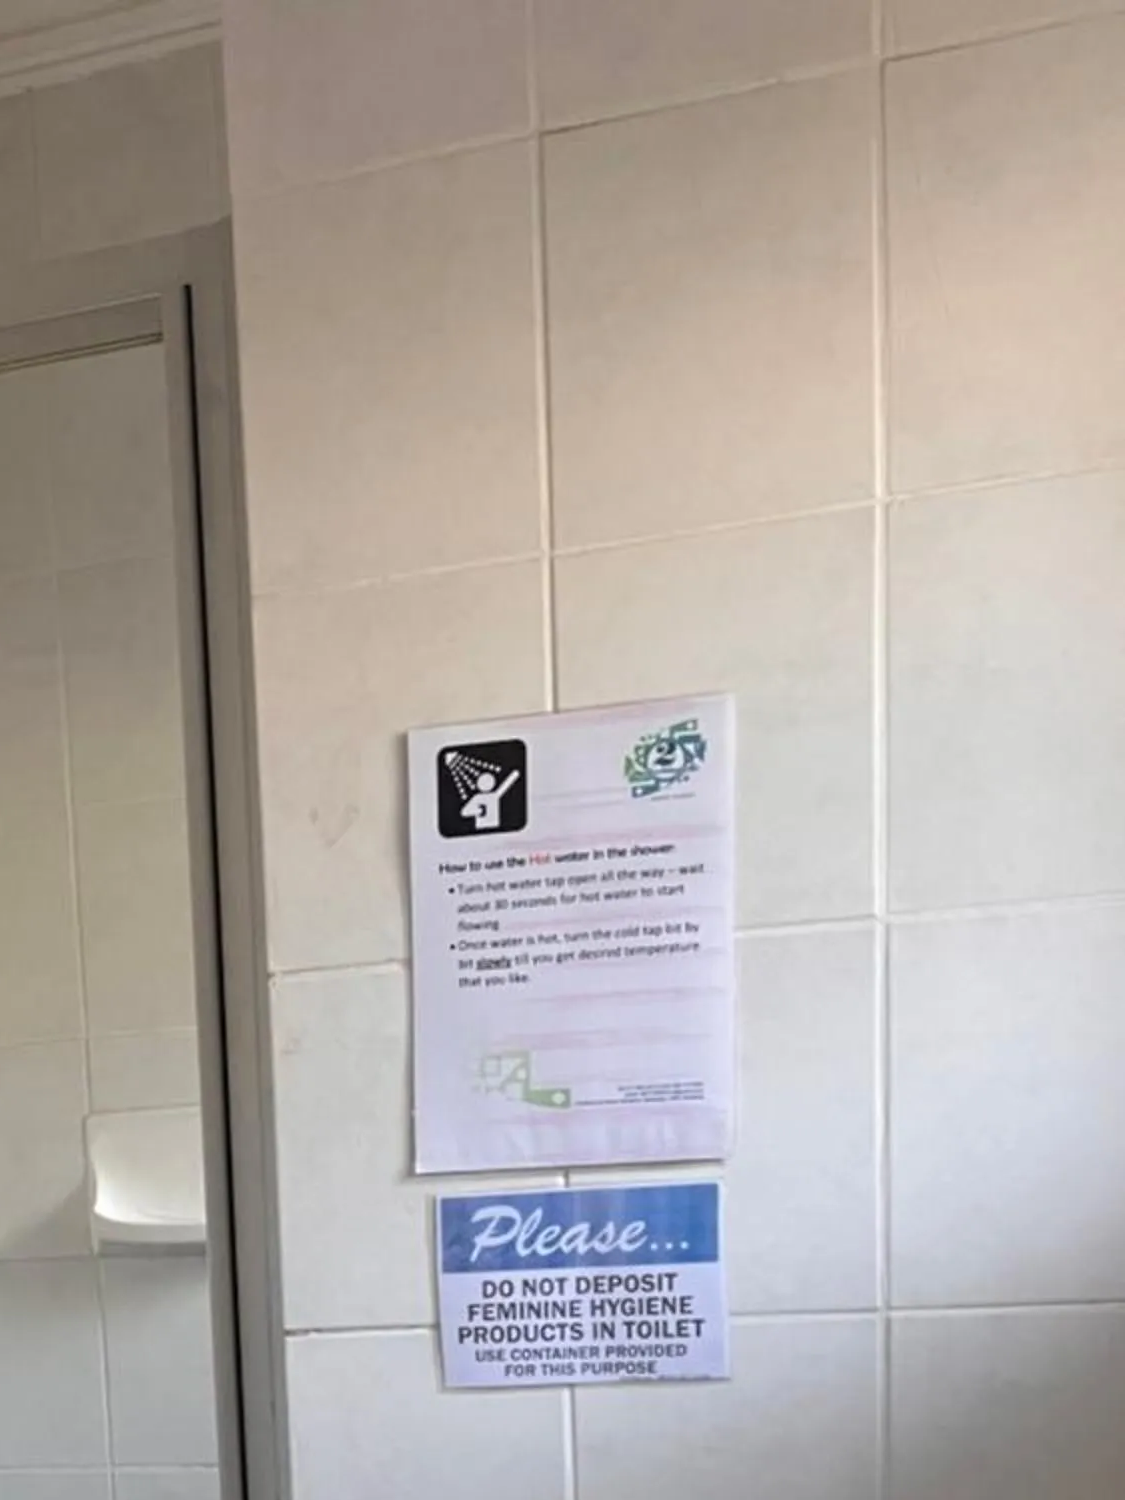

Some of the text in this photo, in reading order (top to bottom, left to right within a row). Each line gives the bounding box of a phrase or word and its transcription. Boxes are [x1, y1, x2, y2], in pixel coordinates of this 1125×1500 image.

[438, 844, 675, 874] How to use the Hot water in the shower
[457, 882, 483, 895] Turn
[486, 880, 505, 892] hot
[508, 878, 542, 890] water
[545, 876, 565, 889] tap
[567, 873, 597, 887] open
[600, 870, 615, 882] all
[617, 869, 637, 881] the
[640, 867, 664, 880] way
[678, 862, 704, 875] wait
[457, 884, 684, 914] about 30 seconds for hot water to start
[458, 919, 500, 932] flowing
[458, 939, 487, 951] Once
[489, 937, 524, 949] water
[526, 935, 536, 946] is
[563, 932, 589, 943] turn
[591, 928, 612, 941] the
[614, 926, 640, 939] cold
[642, 925, 664, 938] tap
[665, 922, 682, 935] bit
[684, 920, 700, 934] by
[458, 941, 700, 971] bit slowly till you get desired temperature
[458, 976, 482, 988] that
[485, 975, 507, 989] you
[481, 1272, 679, 1299] DO NOT DEPOSIT
[467, 1295, 695, 1323] FEMININE HYGIENE
[458, 1318, 706, 1345] PRODUCTS IN TOILET
[475, 1344, 688, 1363] USE CONTAINER PROVIDED
[504, 1360, 658, 1377] FOR THIS PURPOSE
